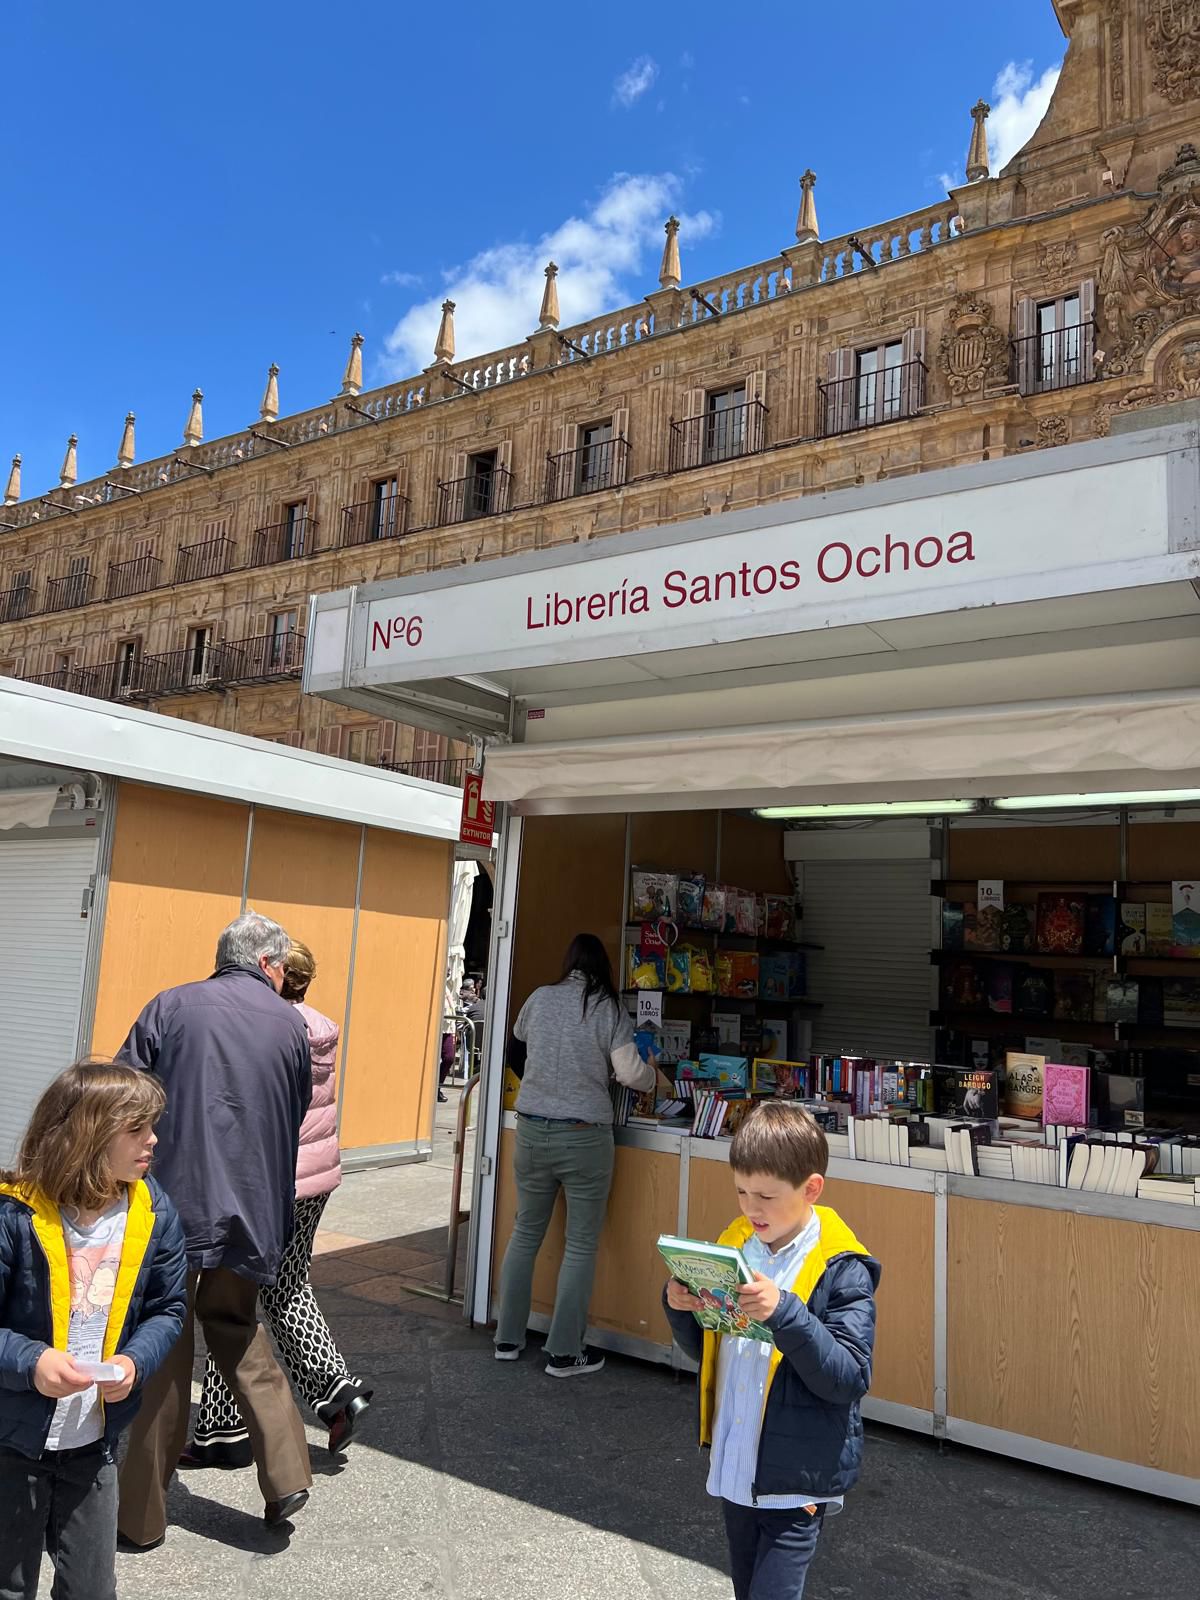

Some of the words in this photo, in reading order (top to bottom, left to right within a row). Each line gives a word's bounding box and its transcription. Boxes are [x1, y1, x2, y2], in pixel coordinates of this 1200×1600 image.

[527, 578, 650, 630] Librería
[662, 560, 800, 609] Santos
[817, 531, 975, 584] Ochoa
[372, 615, 423, 652] Nº6
[463, 828, 491, 841] EXTINTOR
[639, 1000, 652, 1010] 10
[963, 1073, 985, 1082] LEIGH
[1009, 1072, 1033, 1082] ALAS
[958, 1080, 991, 1090] BARDUGO
